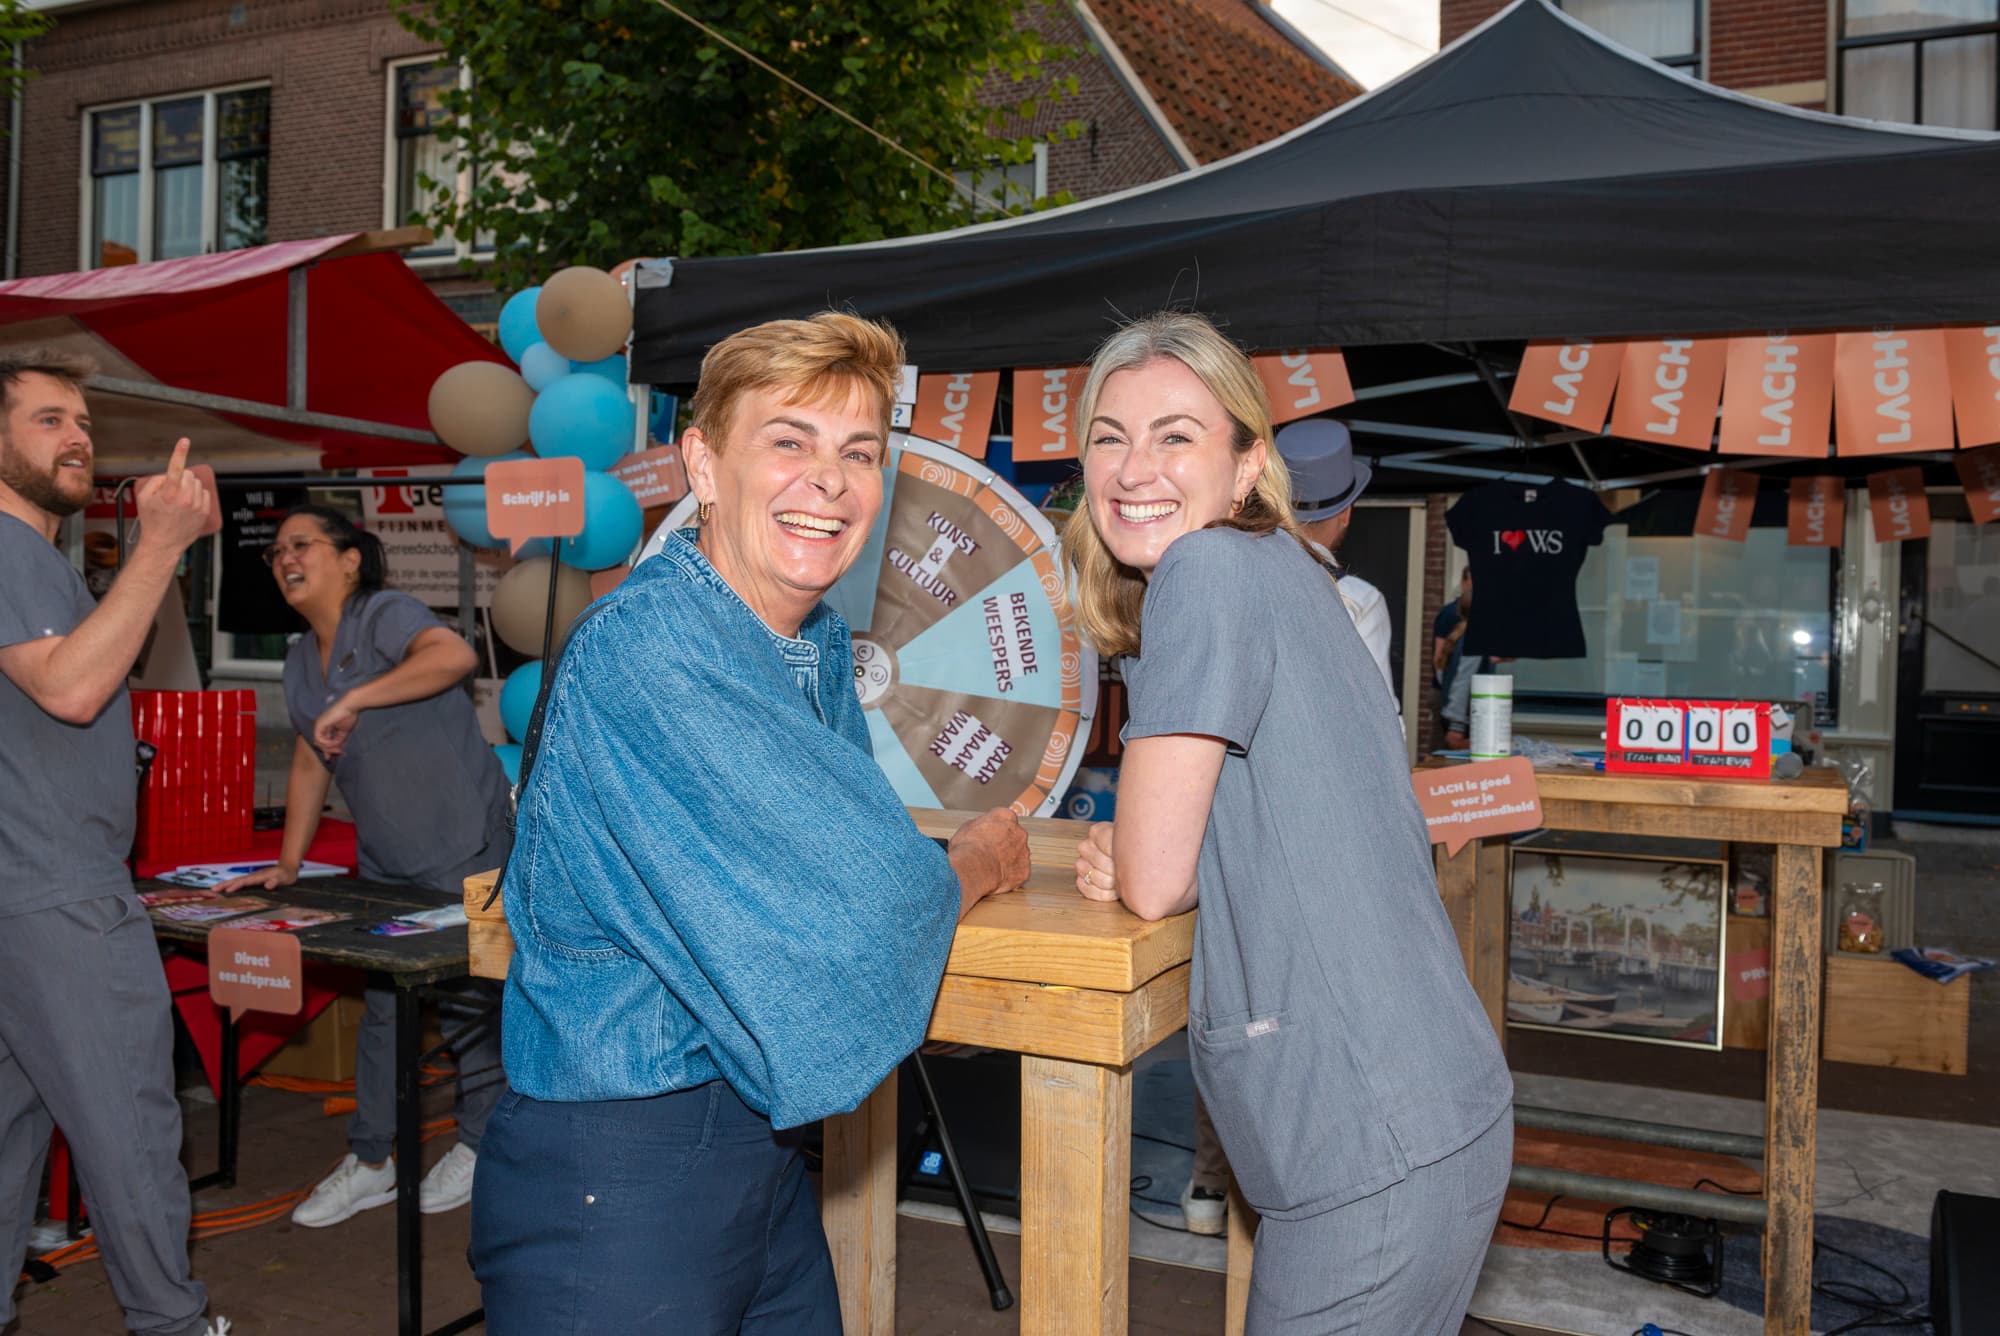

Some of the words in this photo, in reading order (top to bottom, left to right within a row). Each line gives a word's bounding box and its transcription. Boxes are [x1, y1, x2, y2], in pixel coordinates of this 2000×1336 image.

[1041, 369, 1067, 452] LACH
[502, 491, 544, 507] Schrijf
[545, 491, 557, 506] je
[559, 490, 570, 502] in
[926, 510, 982, 557] KUNST
[1493, 530, 1501, 555] I
[1526, 529, 1563, 554] WS
[929, 547, 943, 564] &
[887, 547, 957, 606] CULTUUR
[982, 596, 1013, 693] WEESPERS
[1010, 592, 1038, 676] BEKENDE
[929, 709, 972, 756] WAAR
[951, 724, 992, 771] MAAR
[973, 740, 1013, 784] RAAR
[1429, 782, 1464, 796] LACH
[1466, 780, 1478, 791] is
[1451, 797, 1480, 808] voor
[1482, 793, 1495, 806] je
[1426, 800, 1536, 826] mond)gezondheid
[234, 951, 269, 967] Direct
[219, 971, 238, 983] een
[239, 971, 292, 990] afspraak
